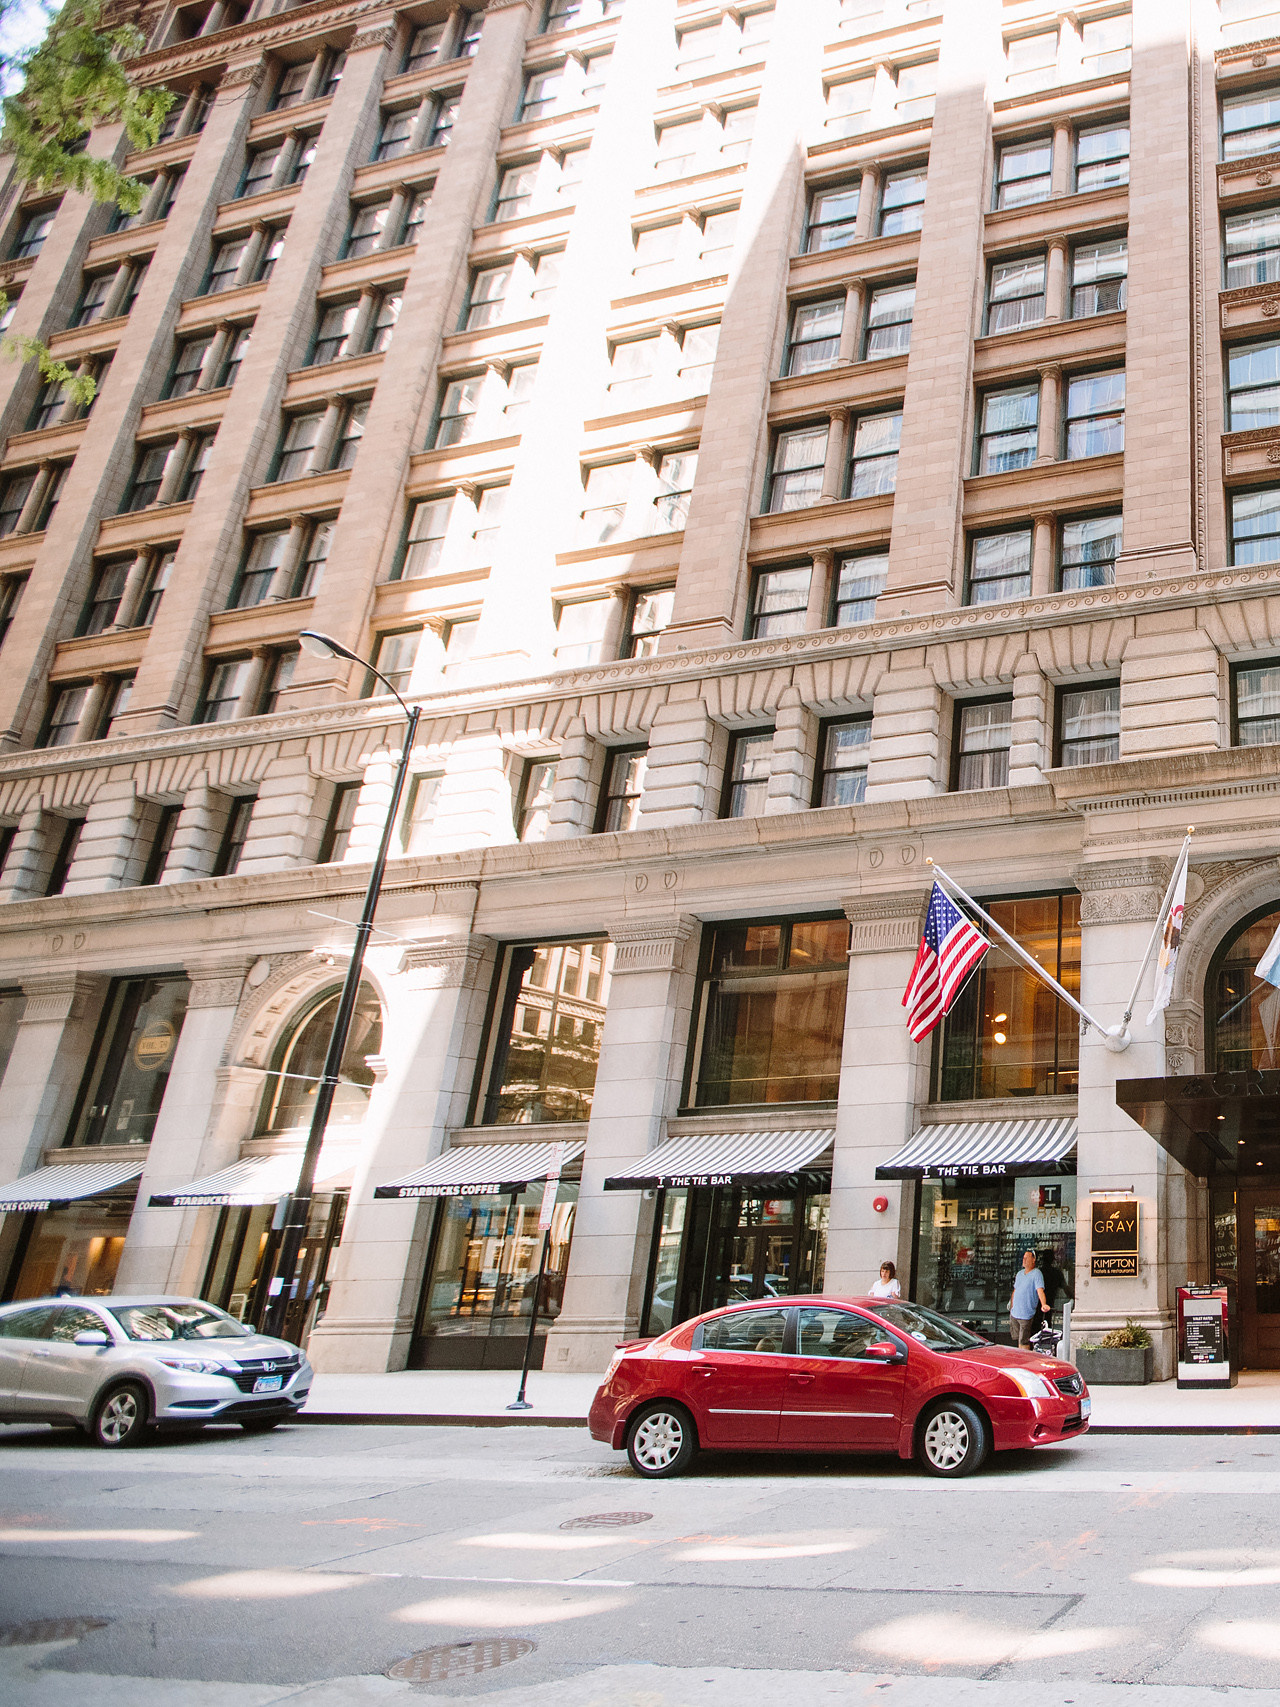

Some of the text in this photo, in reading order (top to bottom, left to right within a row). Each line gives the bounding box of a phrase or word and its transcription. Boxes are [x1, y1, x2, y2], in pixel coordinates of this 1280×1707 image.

[937, 1166, 959, 1176] THE
[961, 1165, 979, 1175] TIE
[982, 1164, 1006, 1175] BAR
[670, 1177, 690, 1186] THE
[692, 1176, 708, 1186] TIE
[710, 1175, 732, 1185] BAR
[399, 1183, 501, 1198] STARBUCKS COFFEE
[18, 1200, 51, 1211] COFFEE
[173, 1195, 230, 1206] STARBUCKS
[967, 1207, 999, 1221] THE
[1037, 1205, 1070, 1218] BAR
[1060, 1215, 1075, 1224] BA
[1094, 1219, 1135, 1233] GRAY
[1093, 1258, 1135, 1268] KIMPTON
